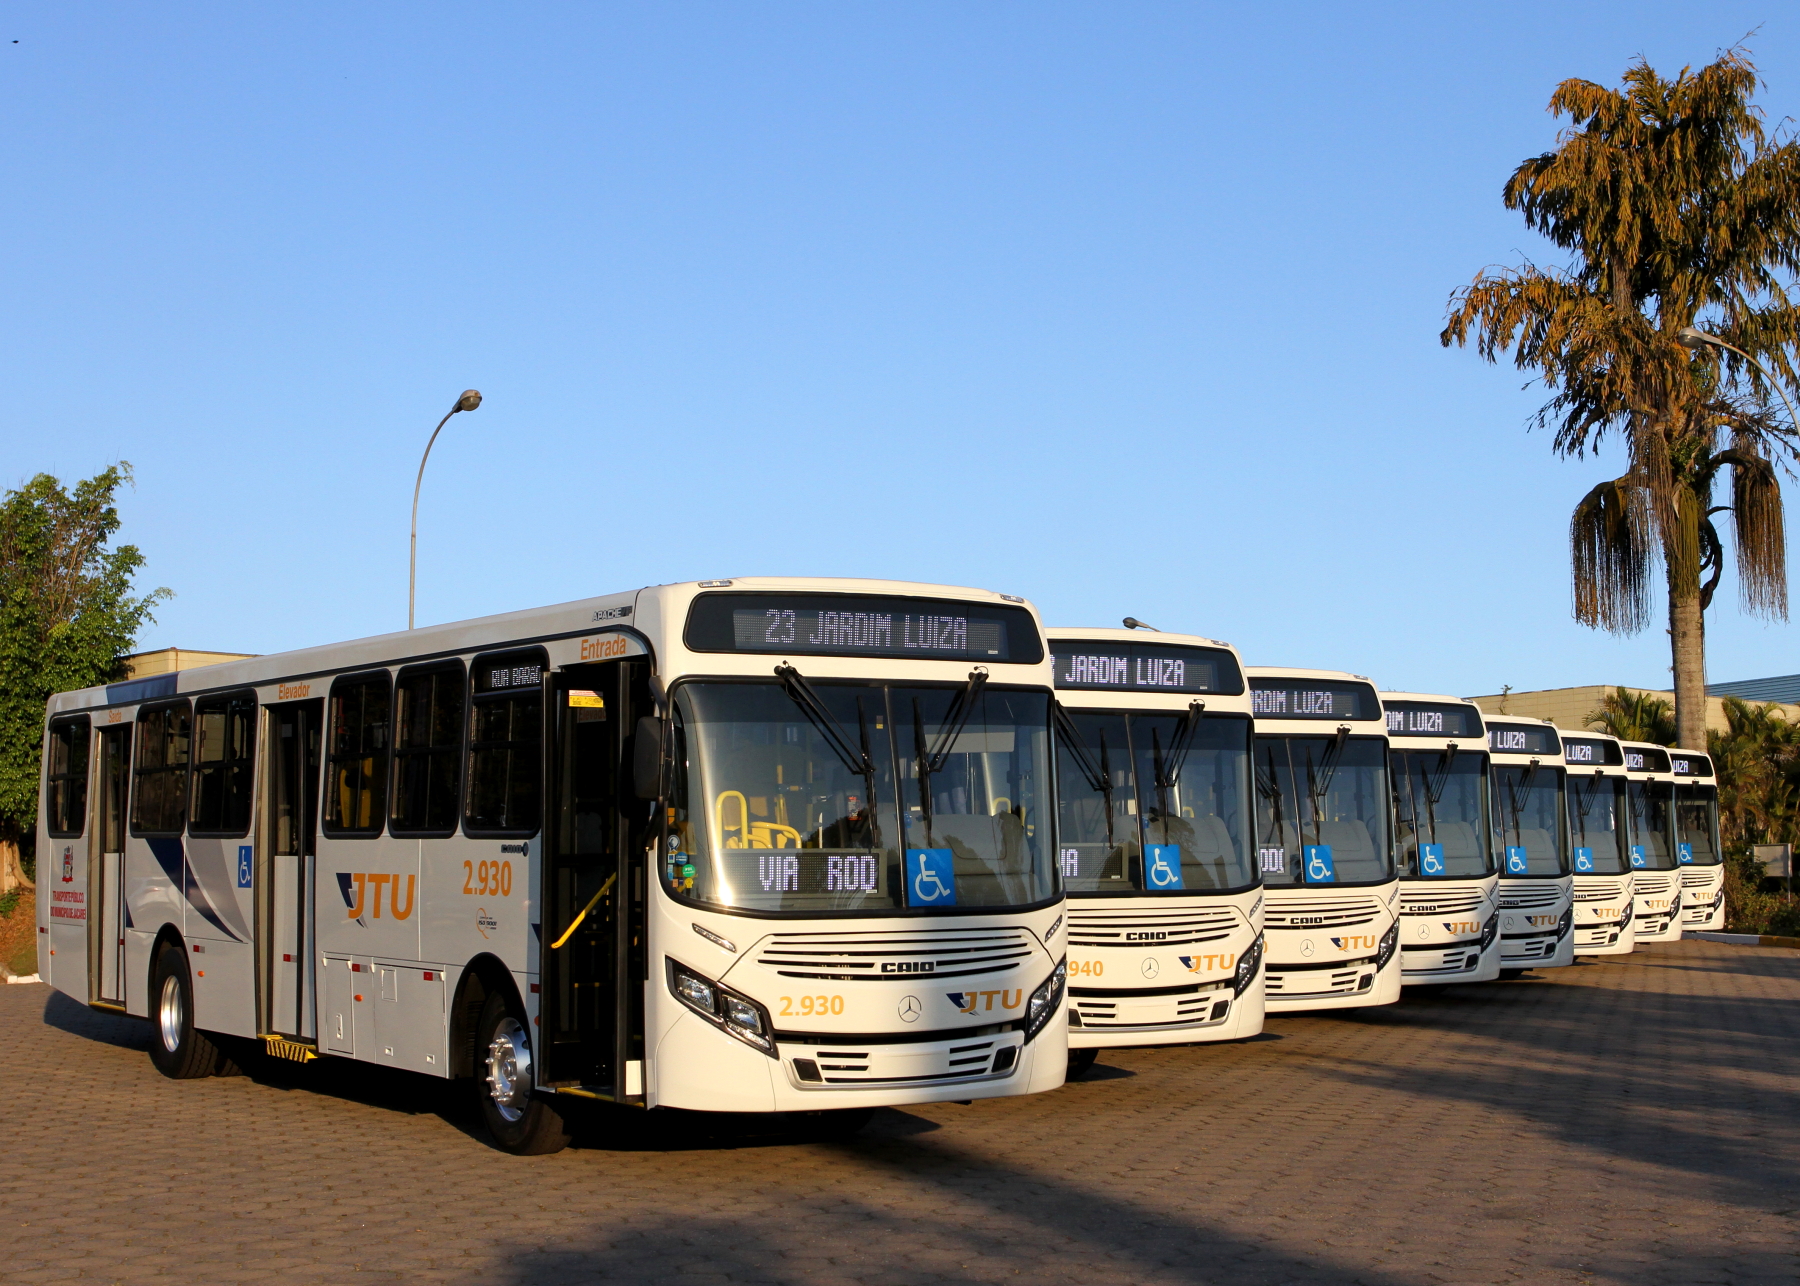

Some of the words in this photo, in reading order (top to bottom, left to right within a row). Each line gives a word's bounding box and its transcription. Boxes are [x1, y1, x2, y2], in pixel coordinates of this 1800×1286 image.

[766, 609, 795, 643] 23
[810, 611, 891, 647] JARDIM
[904, 614, 967, 650] LUIZA
[581, 634, 626, 660] Entrada
[1065, 655, 1127, 684] JARDIM
[1136, 658, 1184, 686] LUIZA
[279, 682, 310, 700] Elevador
[1294, 691, 1332, 713] LUIZA
[1410, 712, 1442, 731] LUIZA
[1497, 731, 1526, 748] LUIZA
[1566, 744, 1592, 760] LUIZA
[463, 860, 512, 896] 2.930
[760, 856, 798, 890] VIA
[828, 856, 875, 890] ROD
[348, 873, 415, 920] JTU
[1648, 900, 1669, 908] JTU
[1695, 892, 1714, 900] JTU
[1531, 915, 1557, 926] JTU
[1596, 908, 1620, 917] JTU
[1126, 932, 1167, 940] CAIO
[1449, 922, 1480, 934] JTU
[1339, 935, 1375, 950] JTU
[881, 962, 934, 972] CAIO
[1189, 954, 1234, 972] JTU
[779, 995, 844, 1016] 2.930
[960, 989, 1022, 1013] JTU
